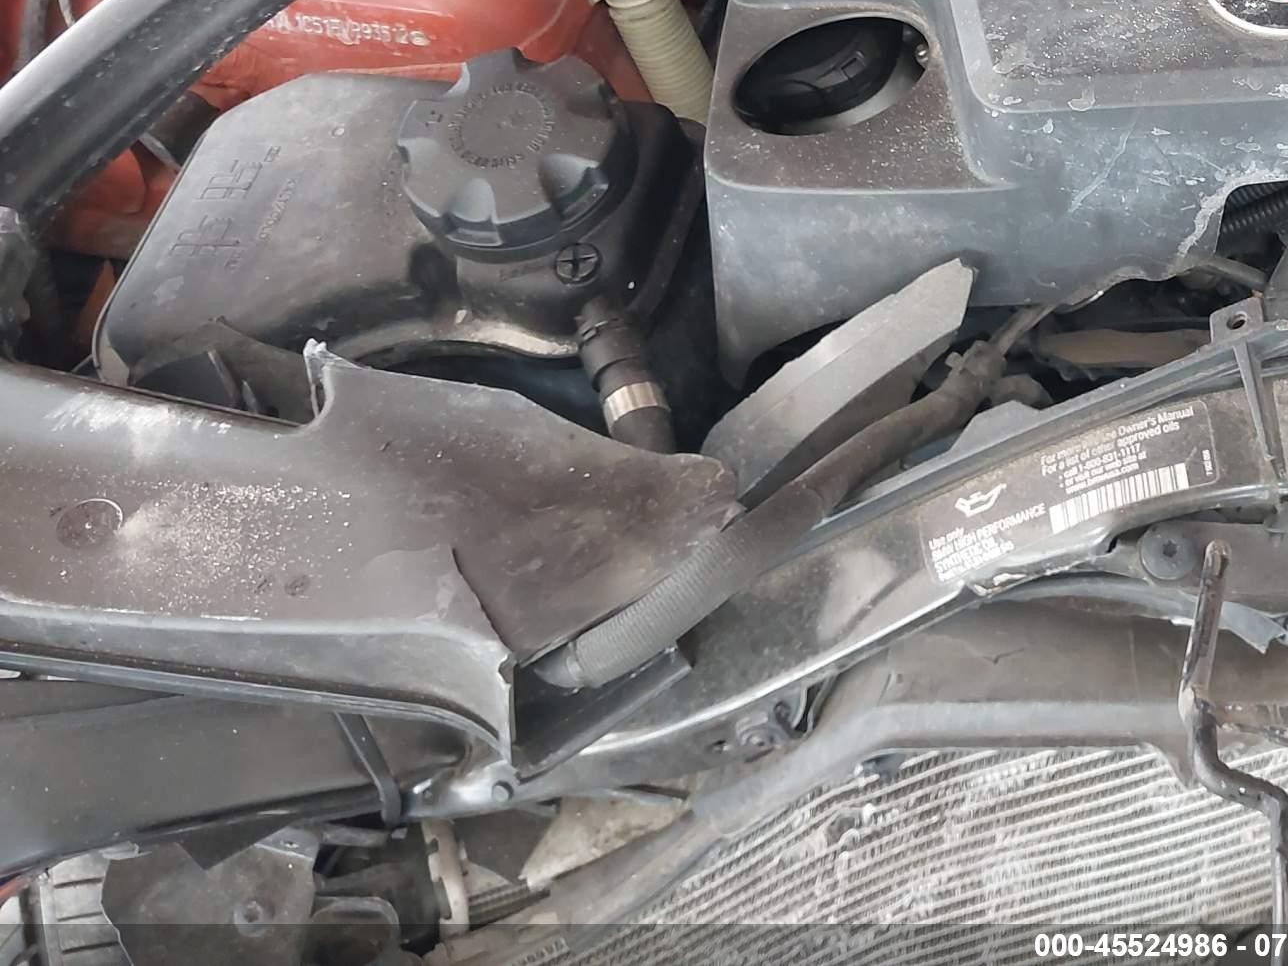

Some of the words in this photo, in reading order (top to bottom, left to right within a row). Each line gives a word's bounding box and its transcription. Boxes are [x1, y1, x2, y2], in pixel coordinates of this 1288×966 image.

[1118, 417, 1157, 435] Owner's
[1157, 405, 1194, 423] Manual
[1041, 463, 1057, 476] For
[1117, 425, 1161, 448] approved
[1162, 421, 1180, 434] oils
[976, 502, 1046, 539] PERFORMANCE
